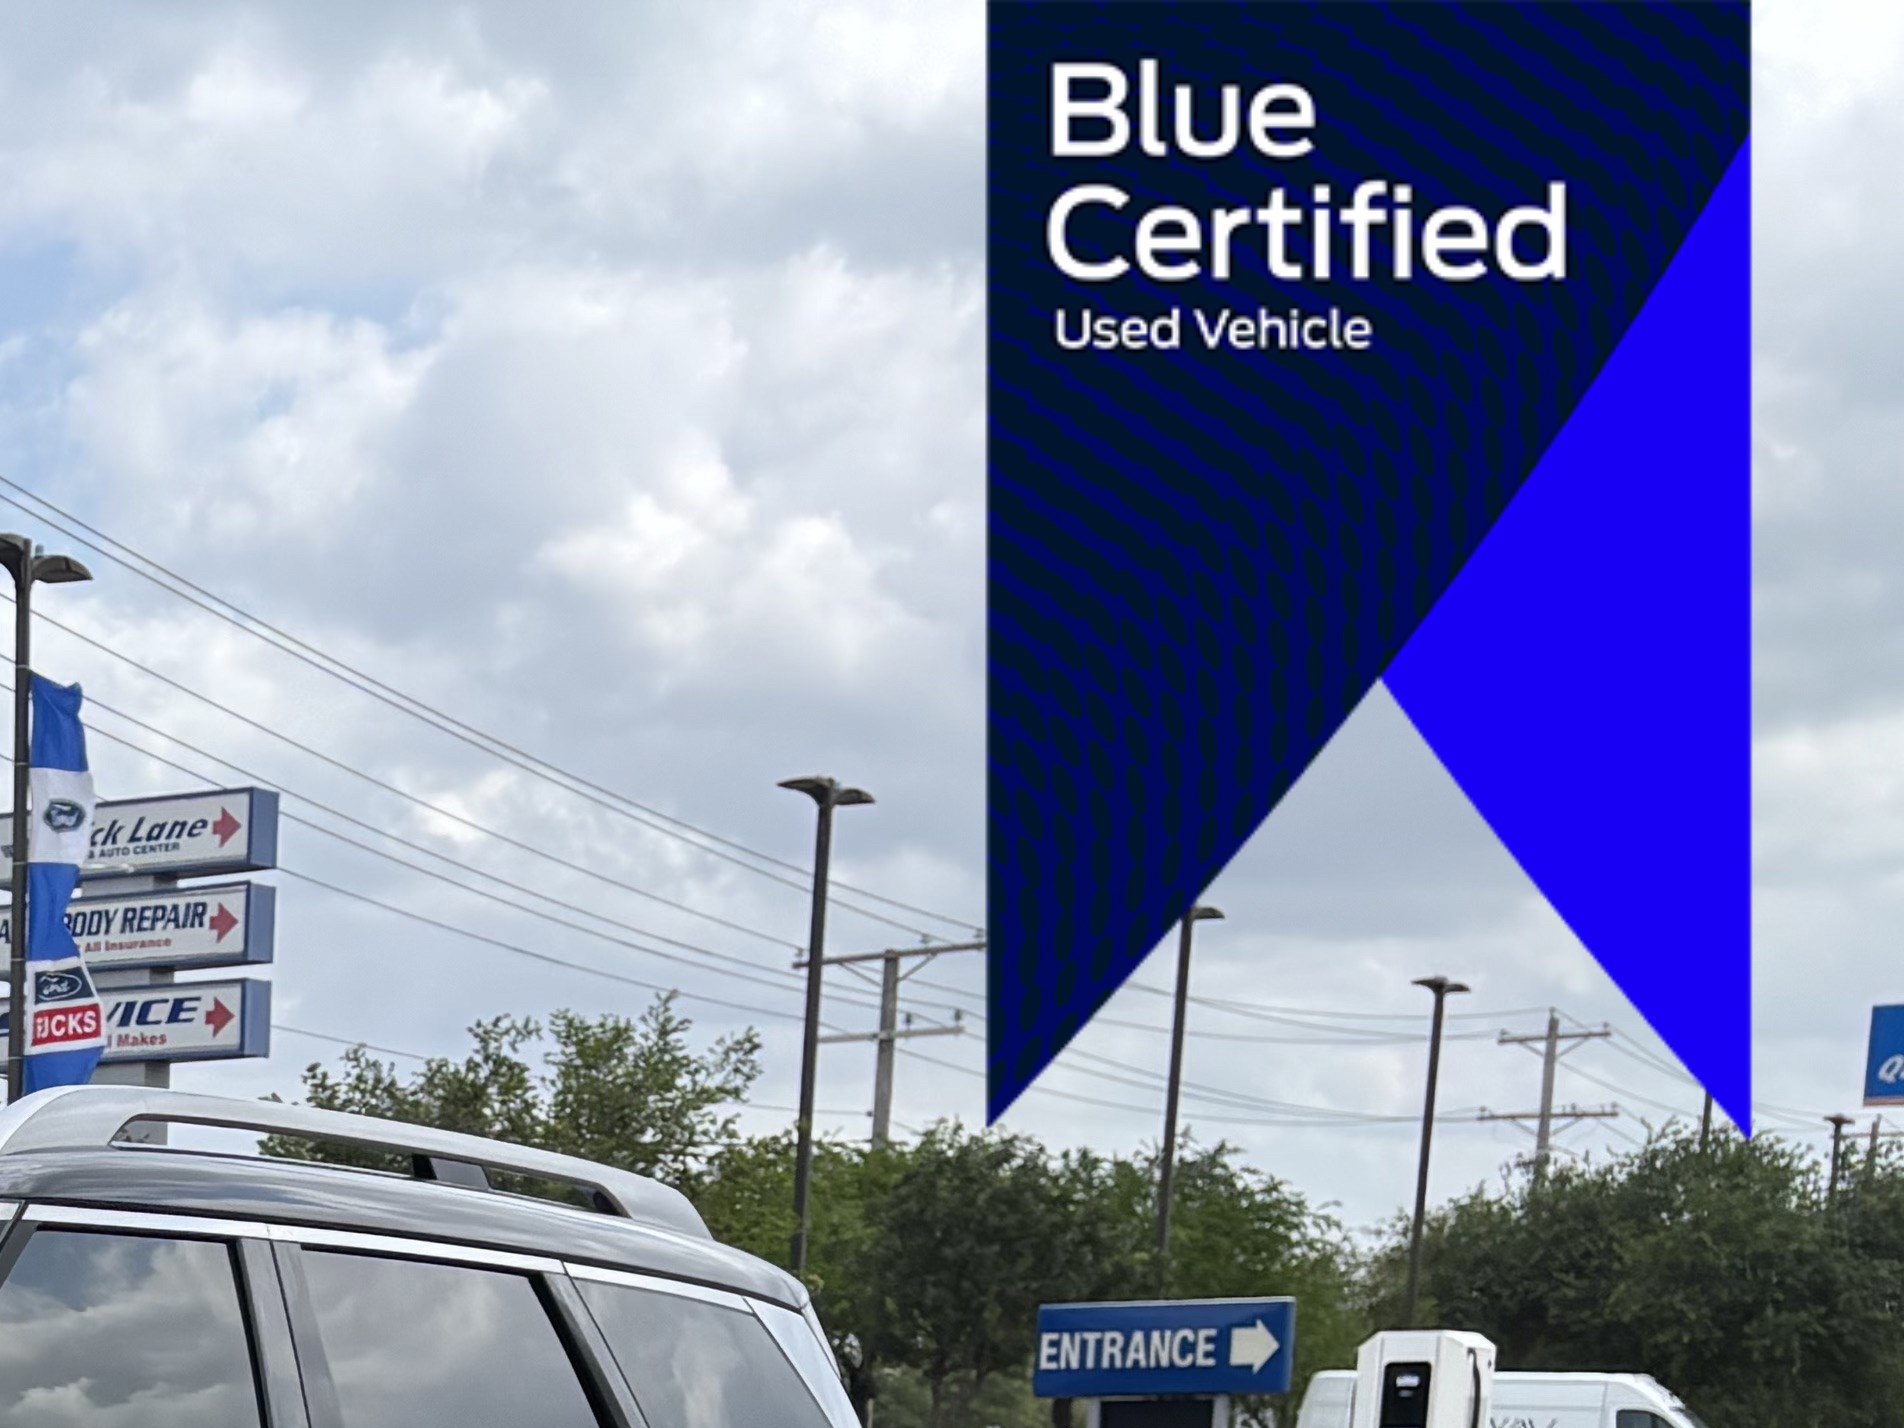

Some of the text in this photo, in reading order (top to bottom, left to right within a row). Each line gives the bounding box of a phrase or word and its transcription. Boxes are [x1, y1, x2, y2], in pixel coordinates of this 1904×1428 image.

[127, 816, 208, 843] Lane
[99, 846, 130, 858] AUTO
[133, 842, 180, 855] CENTER
[120, 902, 207, 934] REPAIR
[105, 938, 171, 952] Insurance
[117, 1032, 167, 1047] Makes
[1039, 1328, 1218, 1371] ENTRANCE
